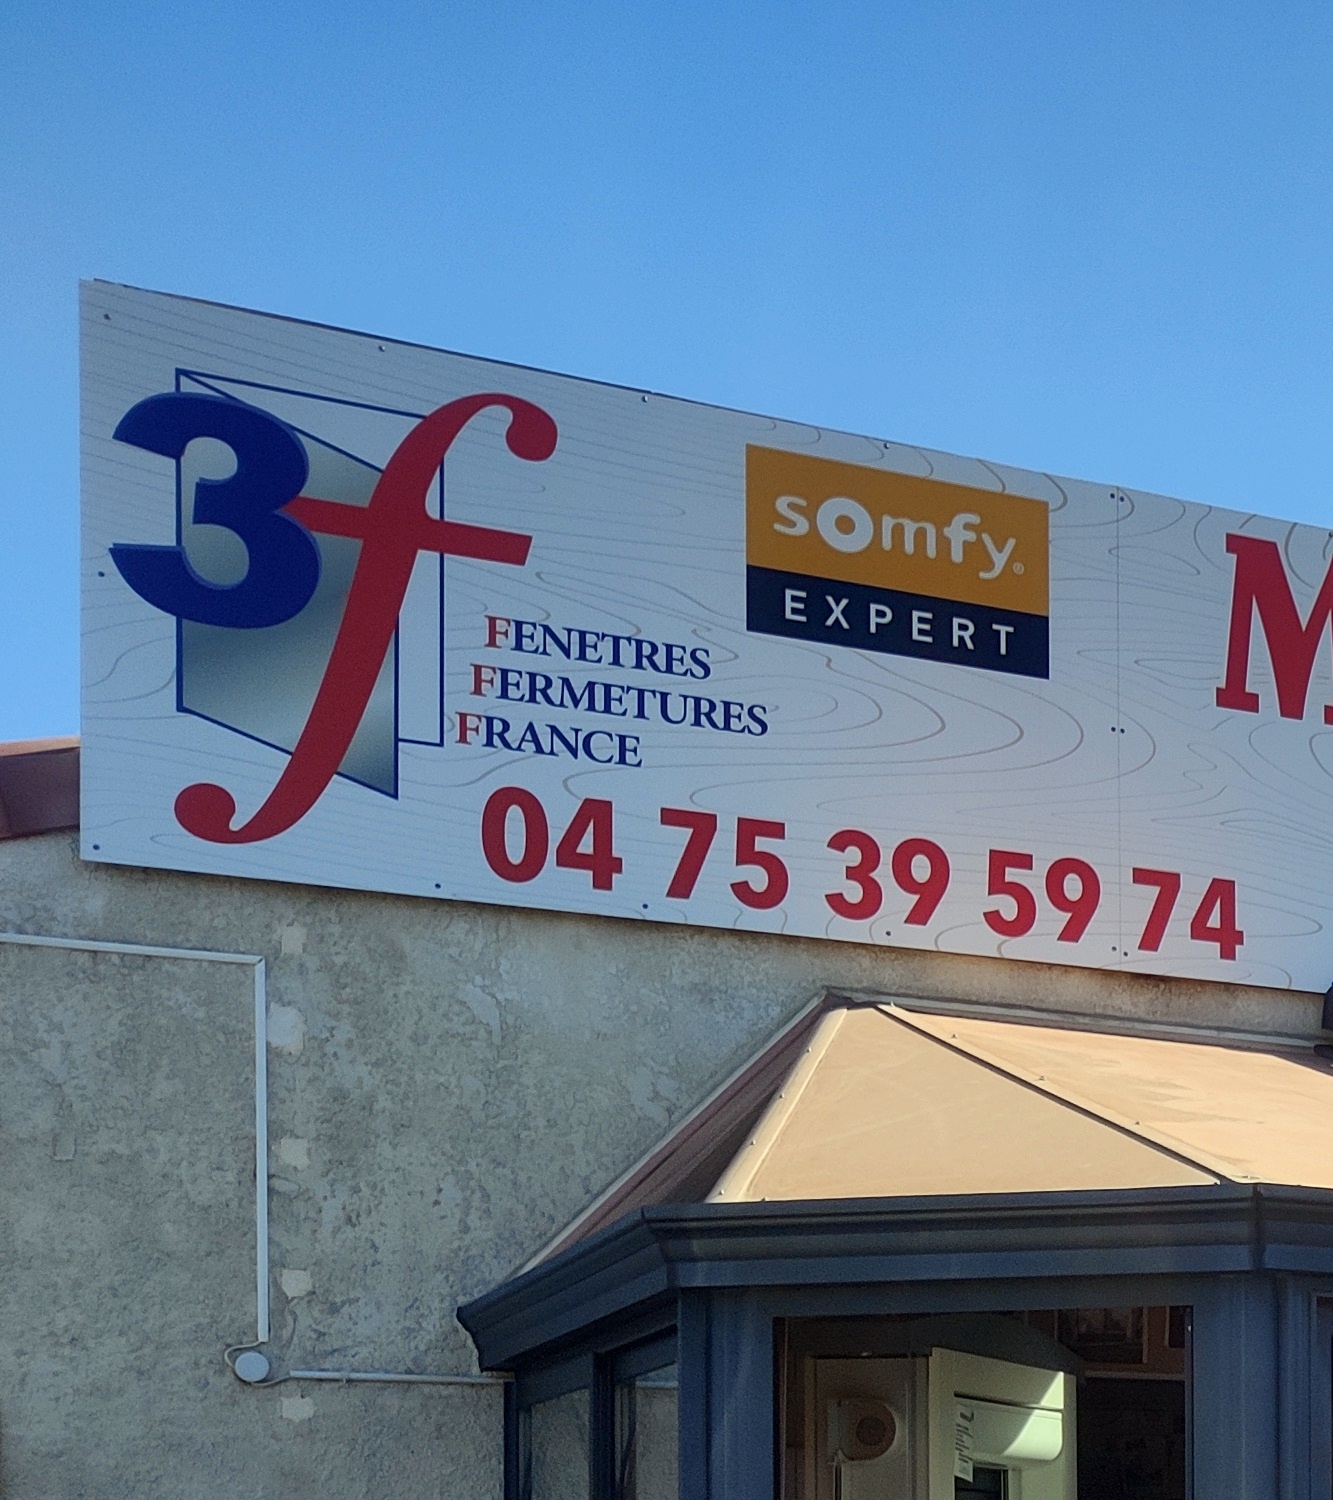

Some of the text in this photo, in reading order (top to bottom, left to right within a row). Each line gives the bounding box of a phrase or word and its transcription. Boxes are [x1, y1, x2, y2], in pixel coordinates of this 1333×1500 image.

[772, 493, 1017, 581] somfy
[483, 614, 712, 681] FENETRES
[784, 588, 1015, 657] EXPERT
[469, 662, 770, 737] FERMETURES
[454, 711, 643, 769] FRANCE
[481, 786, 1244, 960] 04 75 39 59 74
